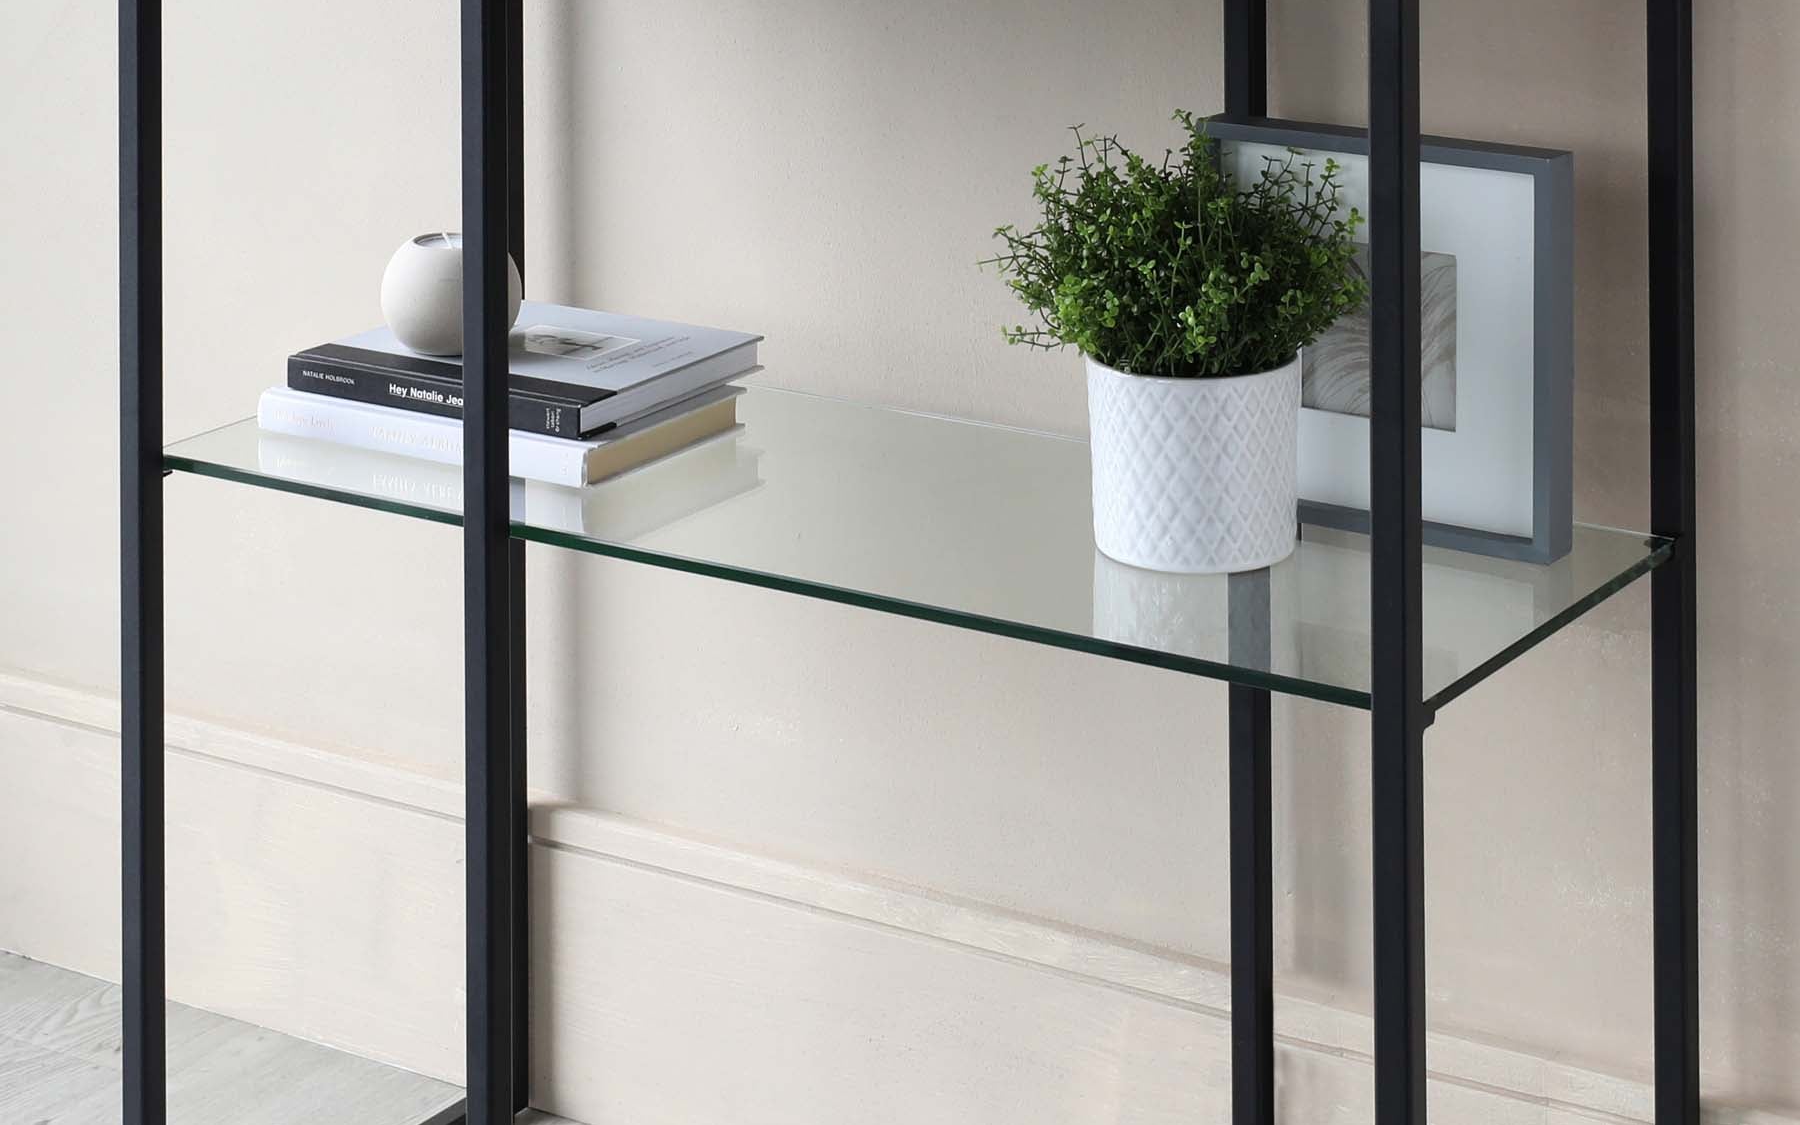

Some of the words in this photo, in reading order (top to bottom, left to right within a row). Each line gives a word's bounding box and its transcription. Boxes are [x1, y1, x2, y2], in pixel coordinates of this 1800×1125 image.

[302, 370, 324, 380] NATALIE
[325, 374, 355, 385] HOLBROOK
[389, 383, 408, 398] Hey
[410, 386, 444, 403] Natalie
[446, 394, 463, 406] Jea
